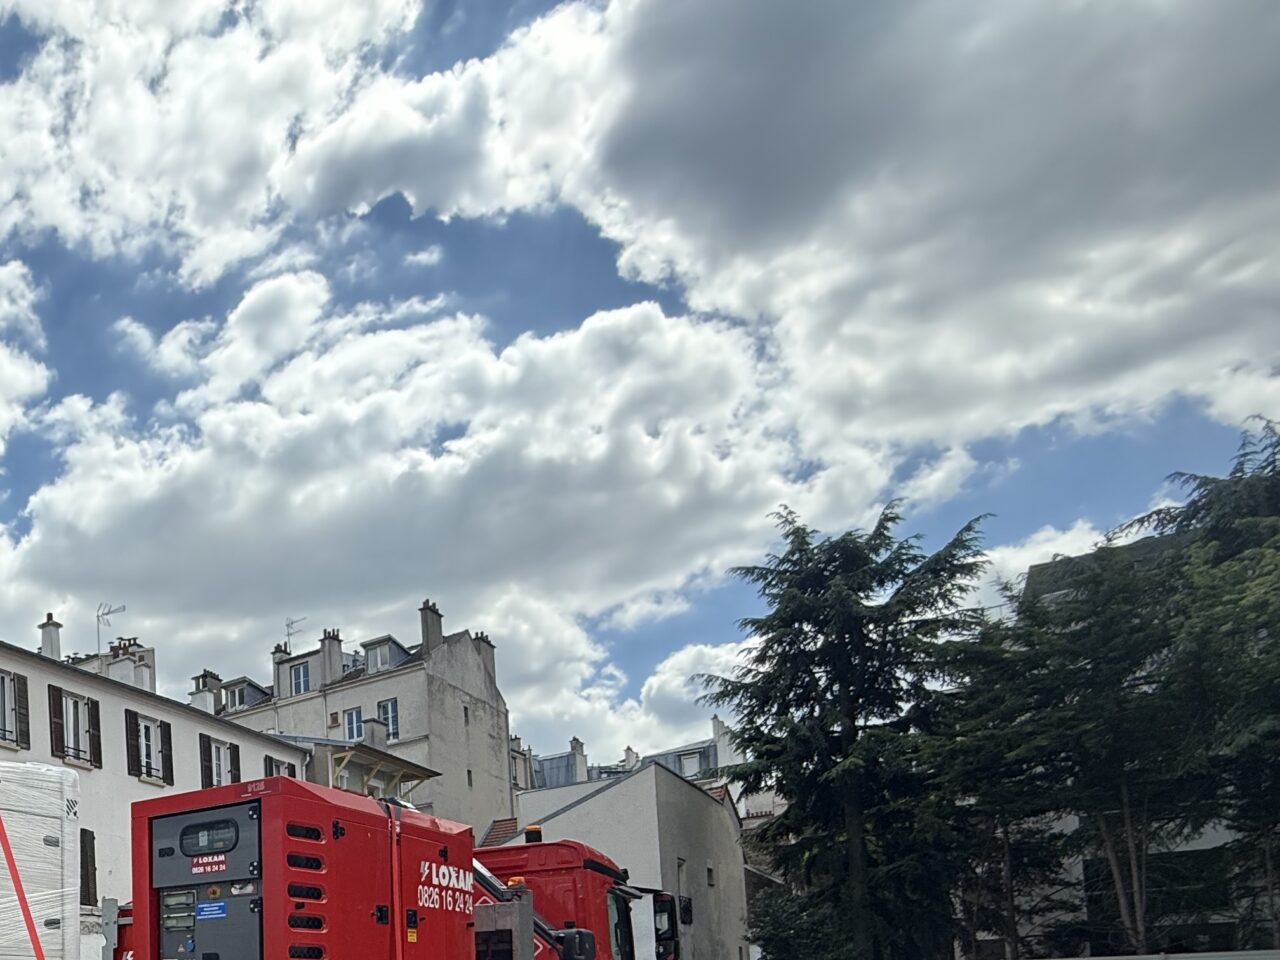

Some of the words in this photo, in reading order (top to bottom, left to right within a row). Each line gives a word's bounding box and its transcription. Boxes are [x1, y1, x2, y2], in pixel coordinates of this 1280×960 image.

[199, 854, 225, 864] LOXAM
[432, 863, 474, 892] LOXAM
[418, 885, 440, 909] 0826
[442, 889, 453, 911] 16
[455, 891, 464, 912] 24
[465, 894, 473, 915] 24
